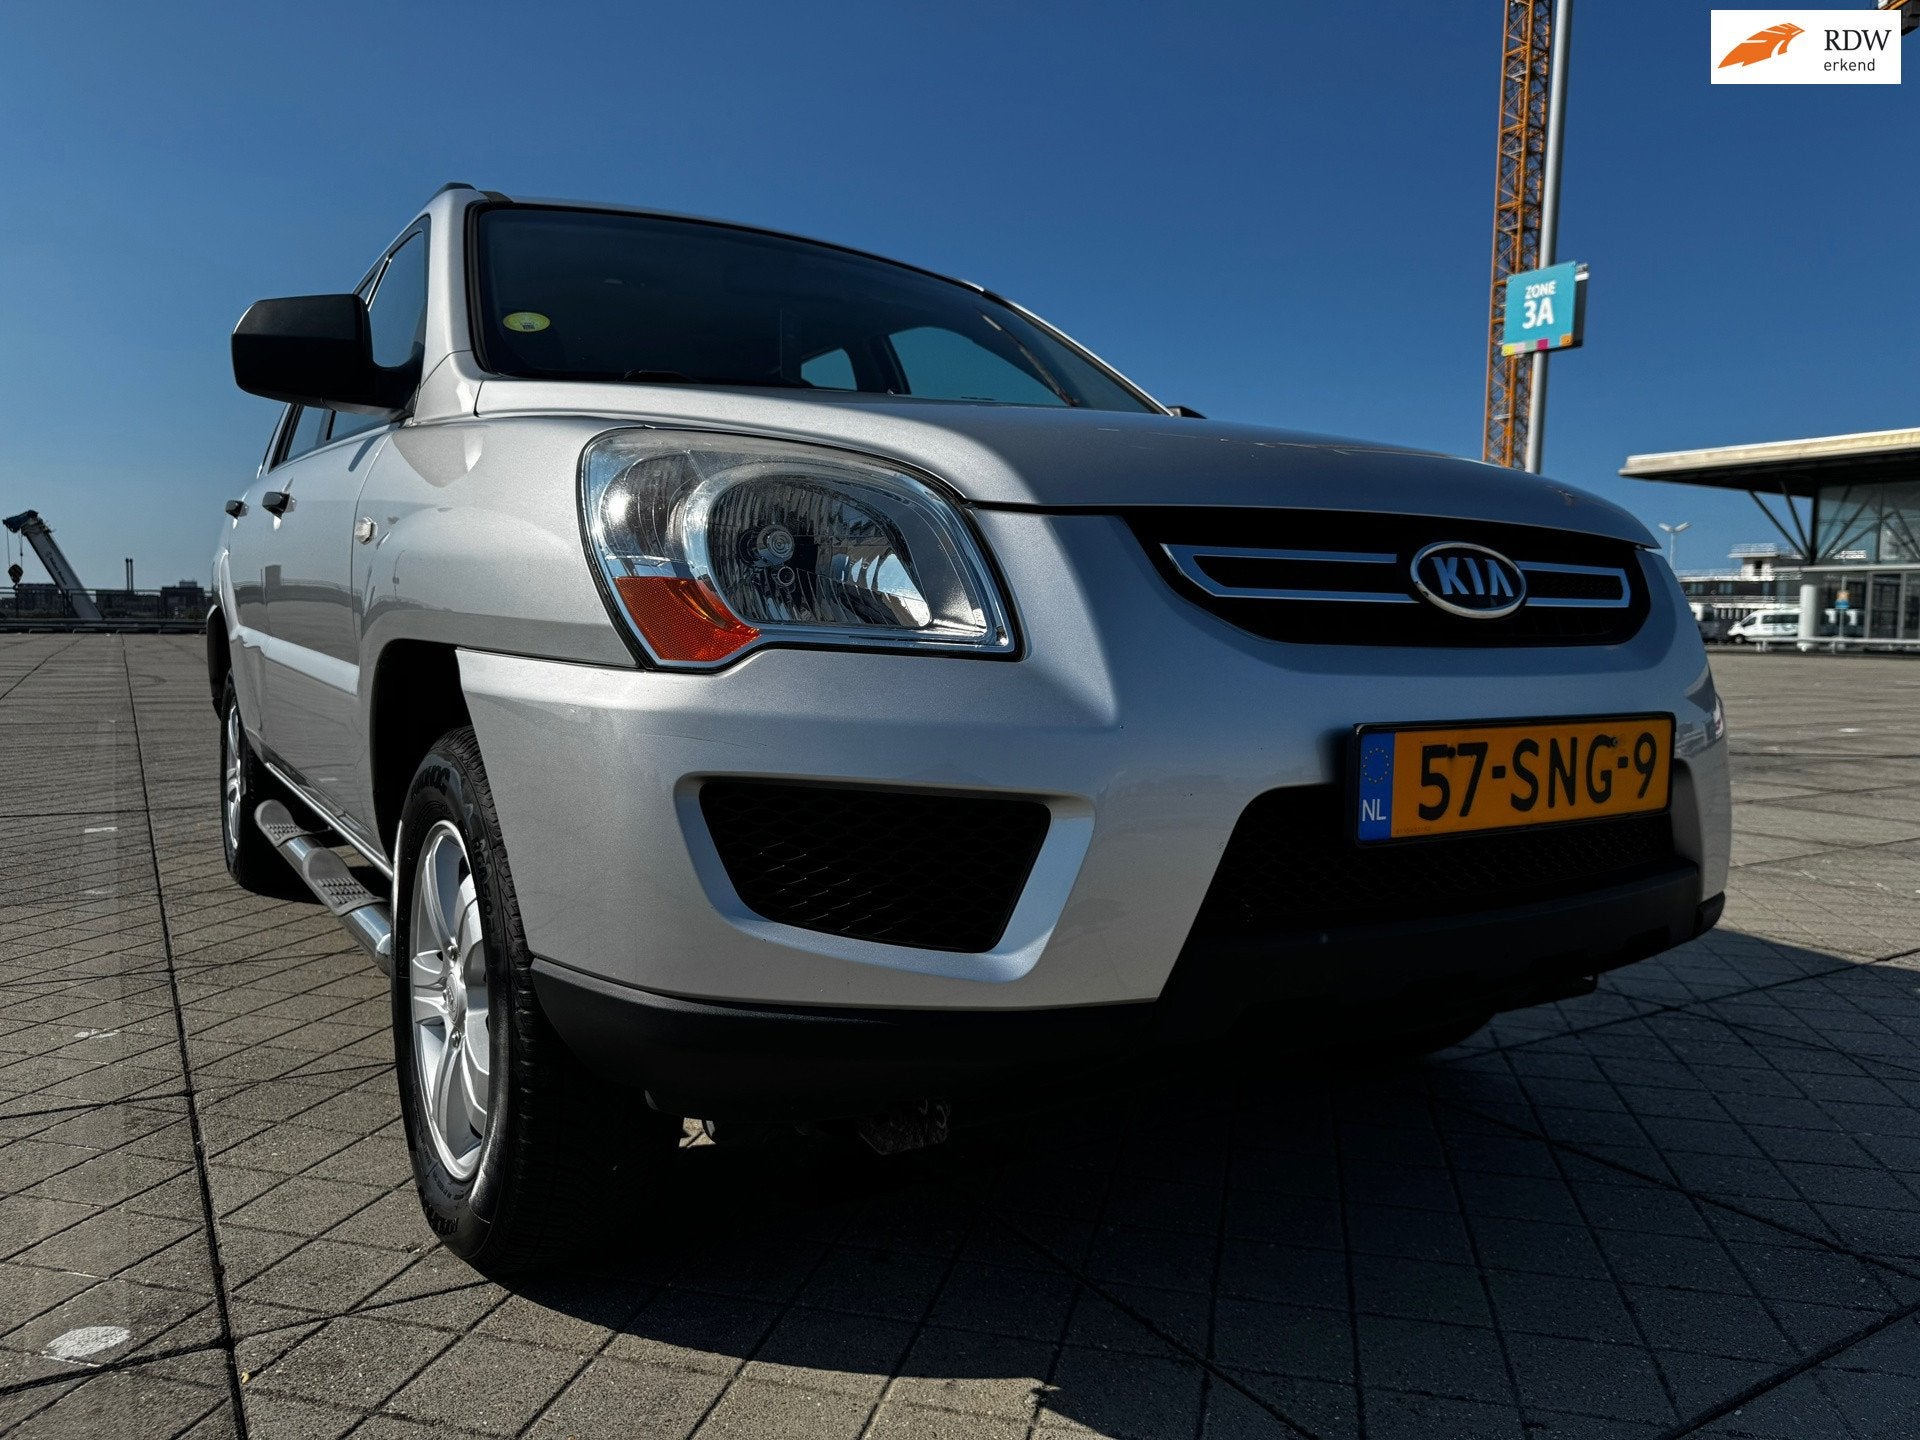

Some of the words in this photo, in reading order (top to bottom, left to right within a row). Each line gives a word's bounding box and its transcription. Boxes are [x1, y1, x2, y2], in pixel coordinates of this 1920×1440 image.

[1525, 280, 1557, 300] ZONE
[1522, 297, 1554, 329] 3A
[1431, 556, 1514, 597] KIA
[1418, 732, 1658, 821] 57-SNG-9
[1361, 798, 1387, 822] NL
